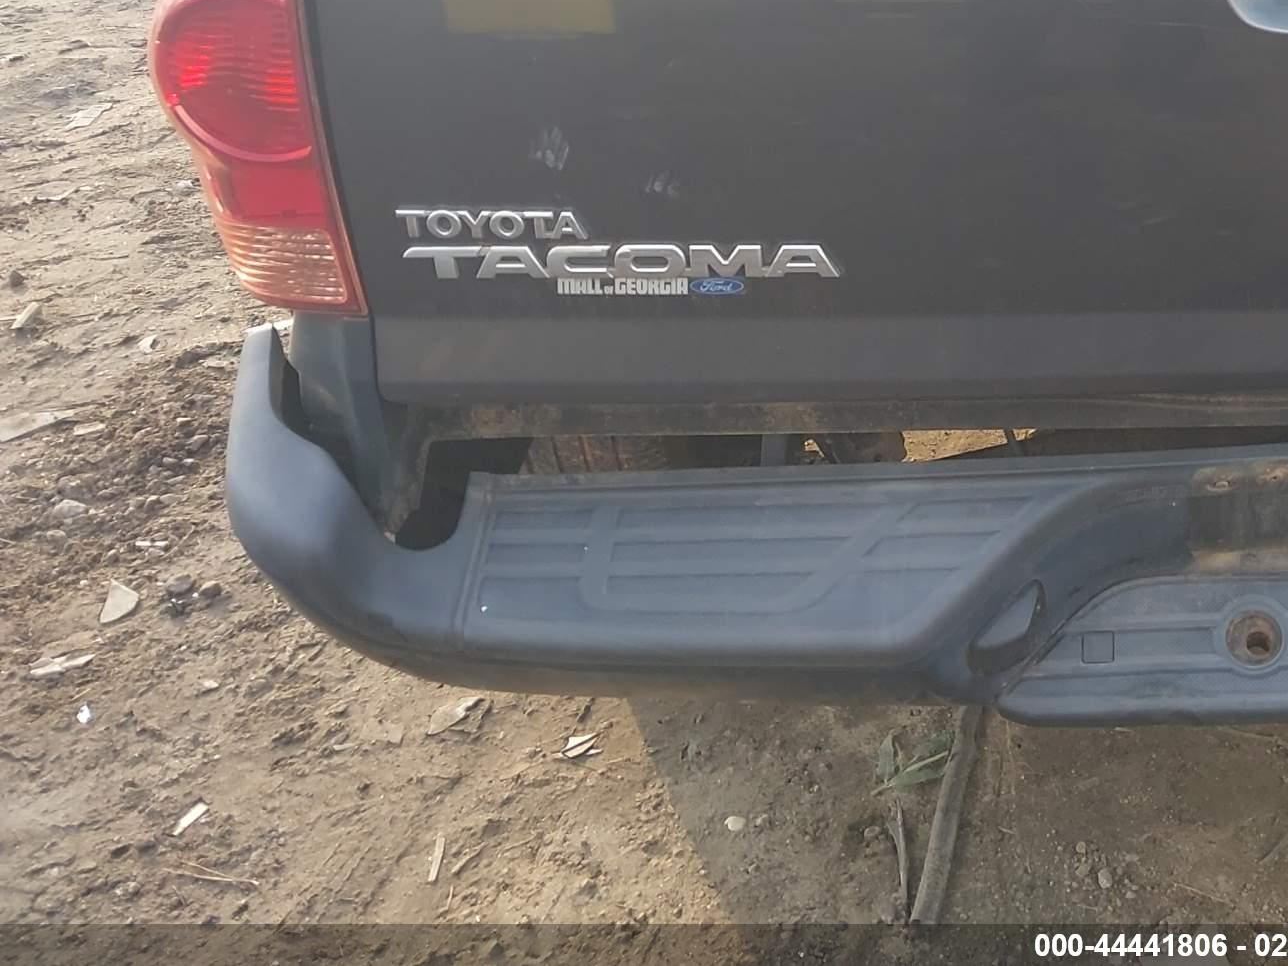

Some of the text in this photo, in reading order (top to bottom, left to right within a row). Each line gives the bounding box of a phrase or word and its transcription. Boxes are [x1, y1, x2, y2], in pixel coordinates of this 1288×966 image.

[395, 209, 588, 239] TOYOTA
[402, 243, 841, 279] TACOMA
[557, 278, 602, 295] MALL
[614, 278, 689, 295] GEORGIA
[699, 279, 733, 292] Ford
